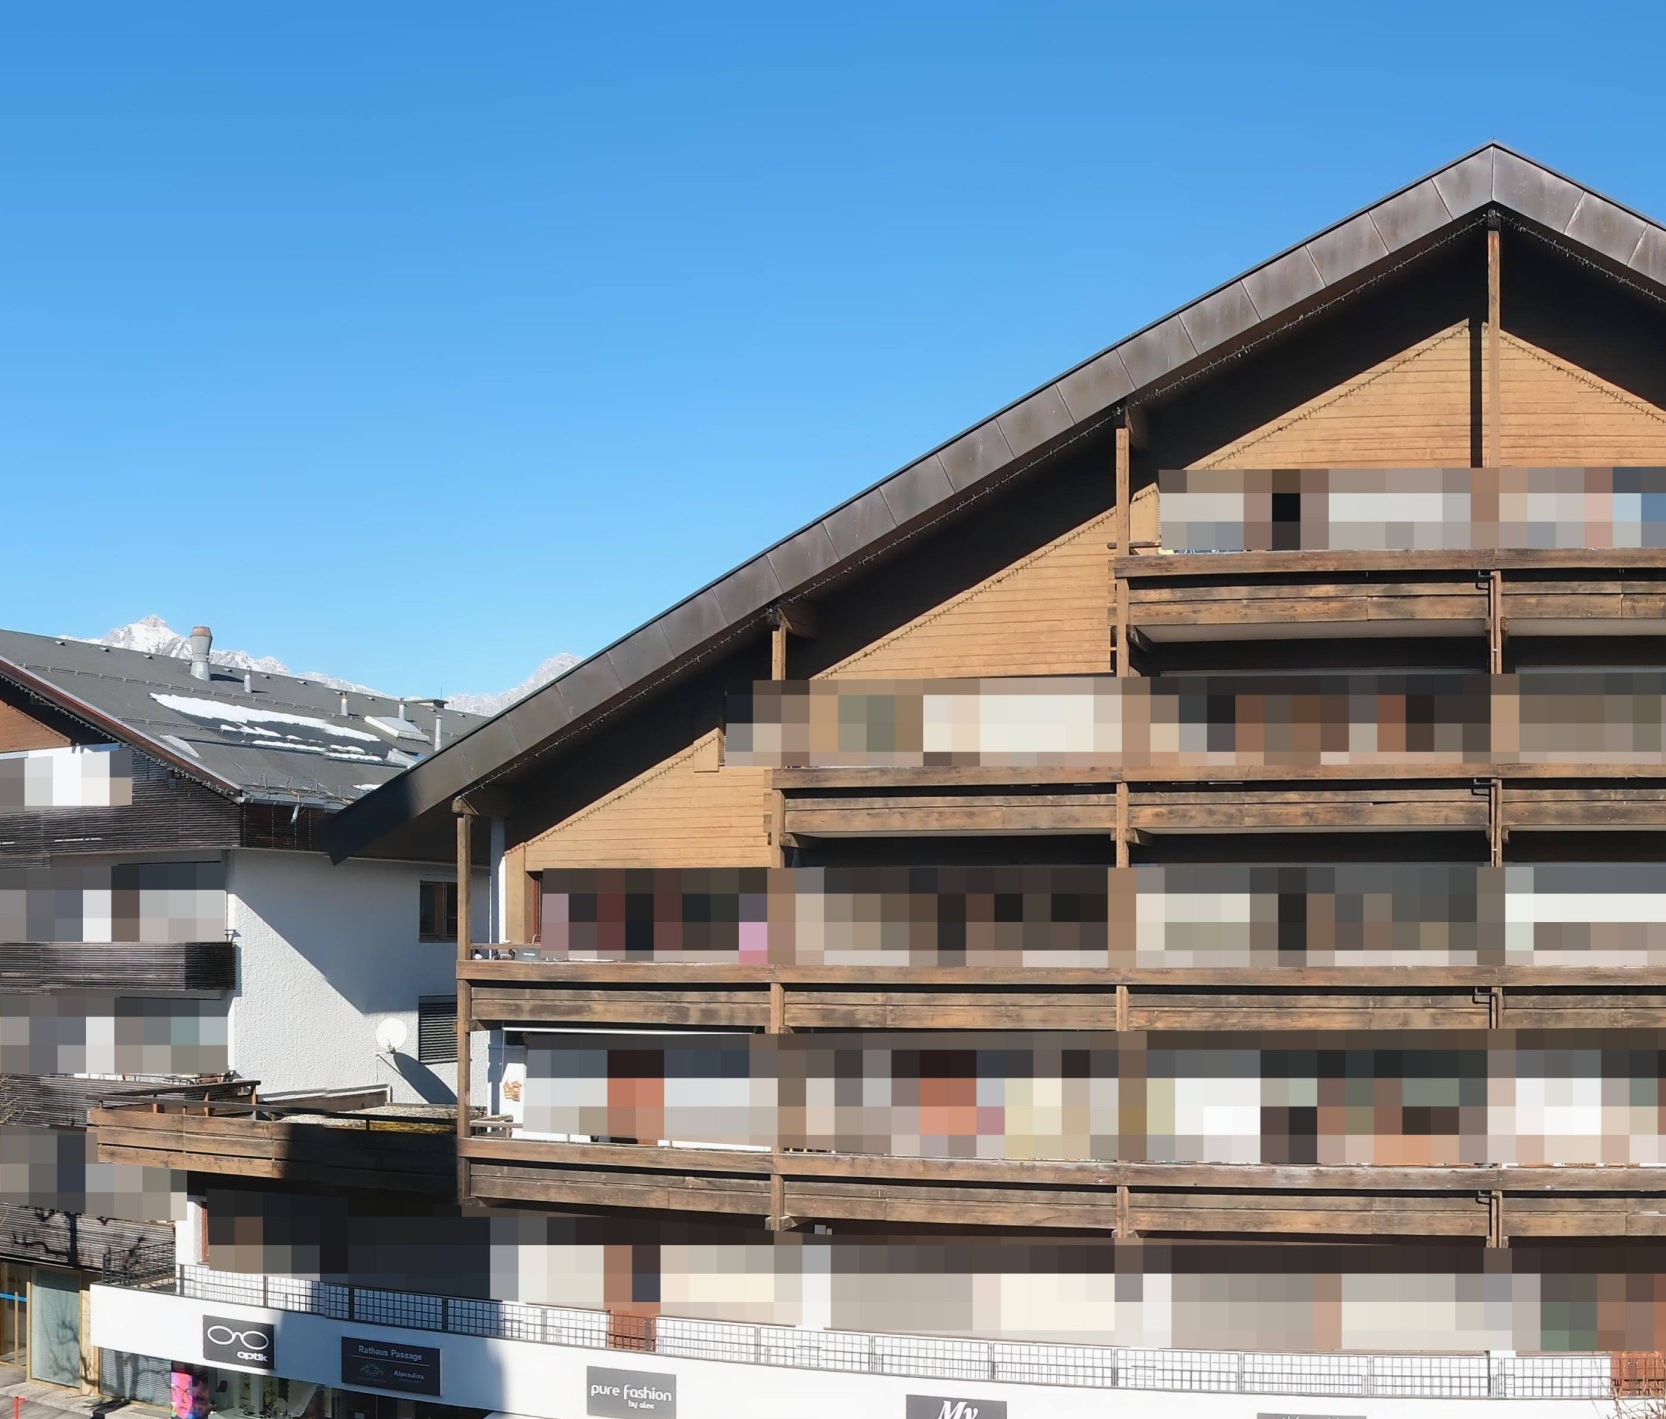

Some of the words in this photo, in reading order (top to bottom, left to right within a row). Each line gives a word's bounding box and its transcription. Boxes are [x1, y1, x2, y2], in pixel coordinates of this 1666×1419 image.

[237, 1350, 268, 1362] optik
[358, 1345, 388, 1357] Rathaus
[391, 1349, 422, 1362] Passage
[591, 1384, 620, 1397] pure
[623, 1384, 672, 1402] fashion
